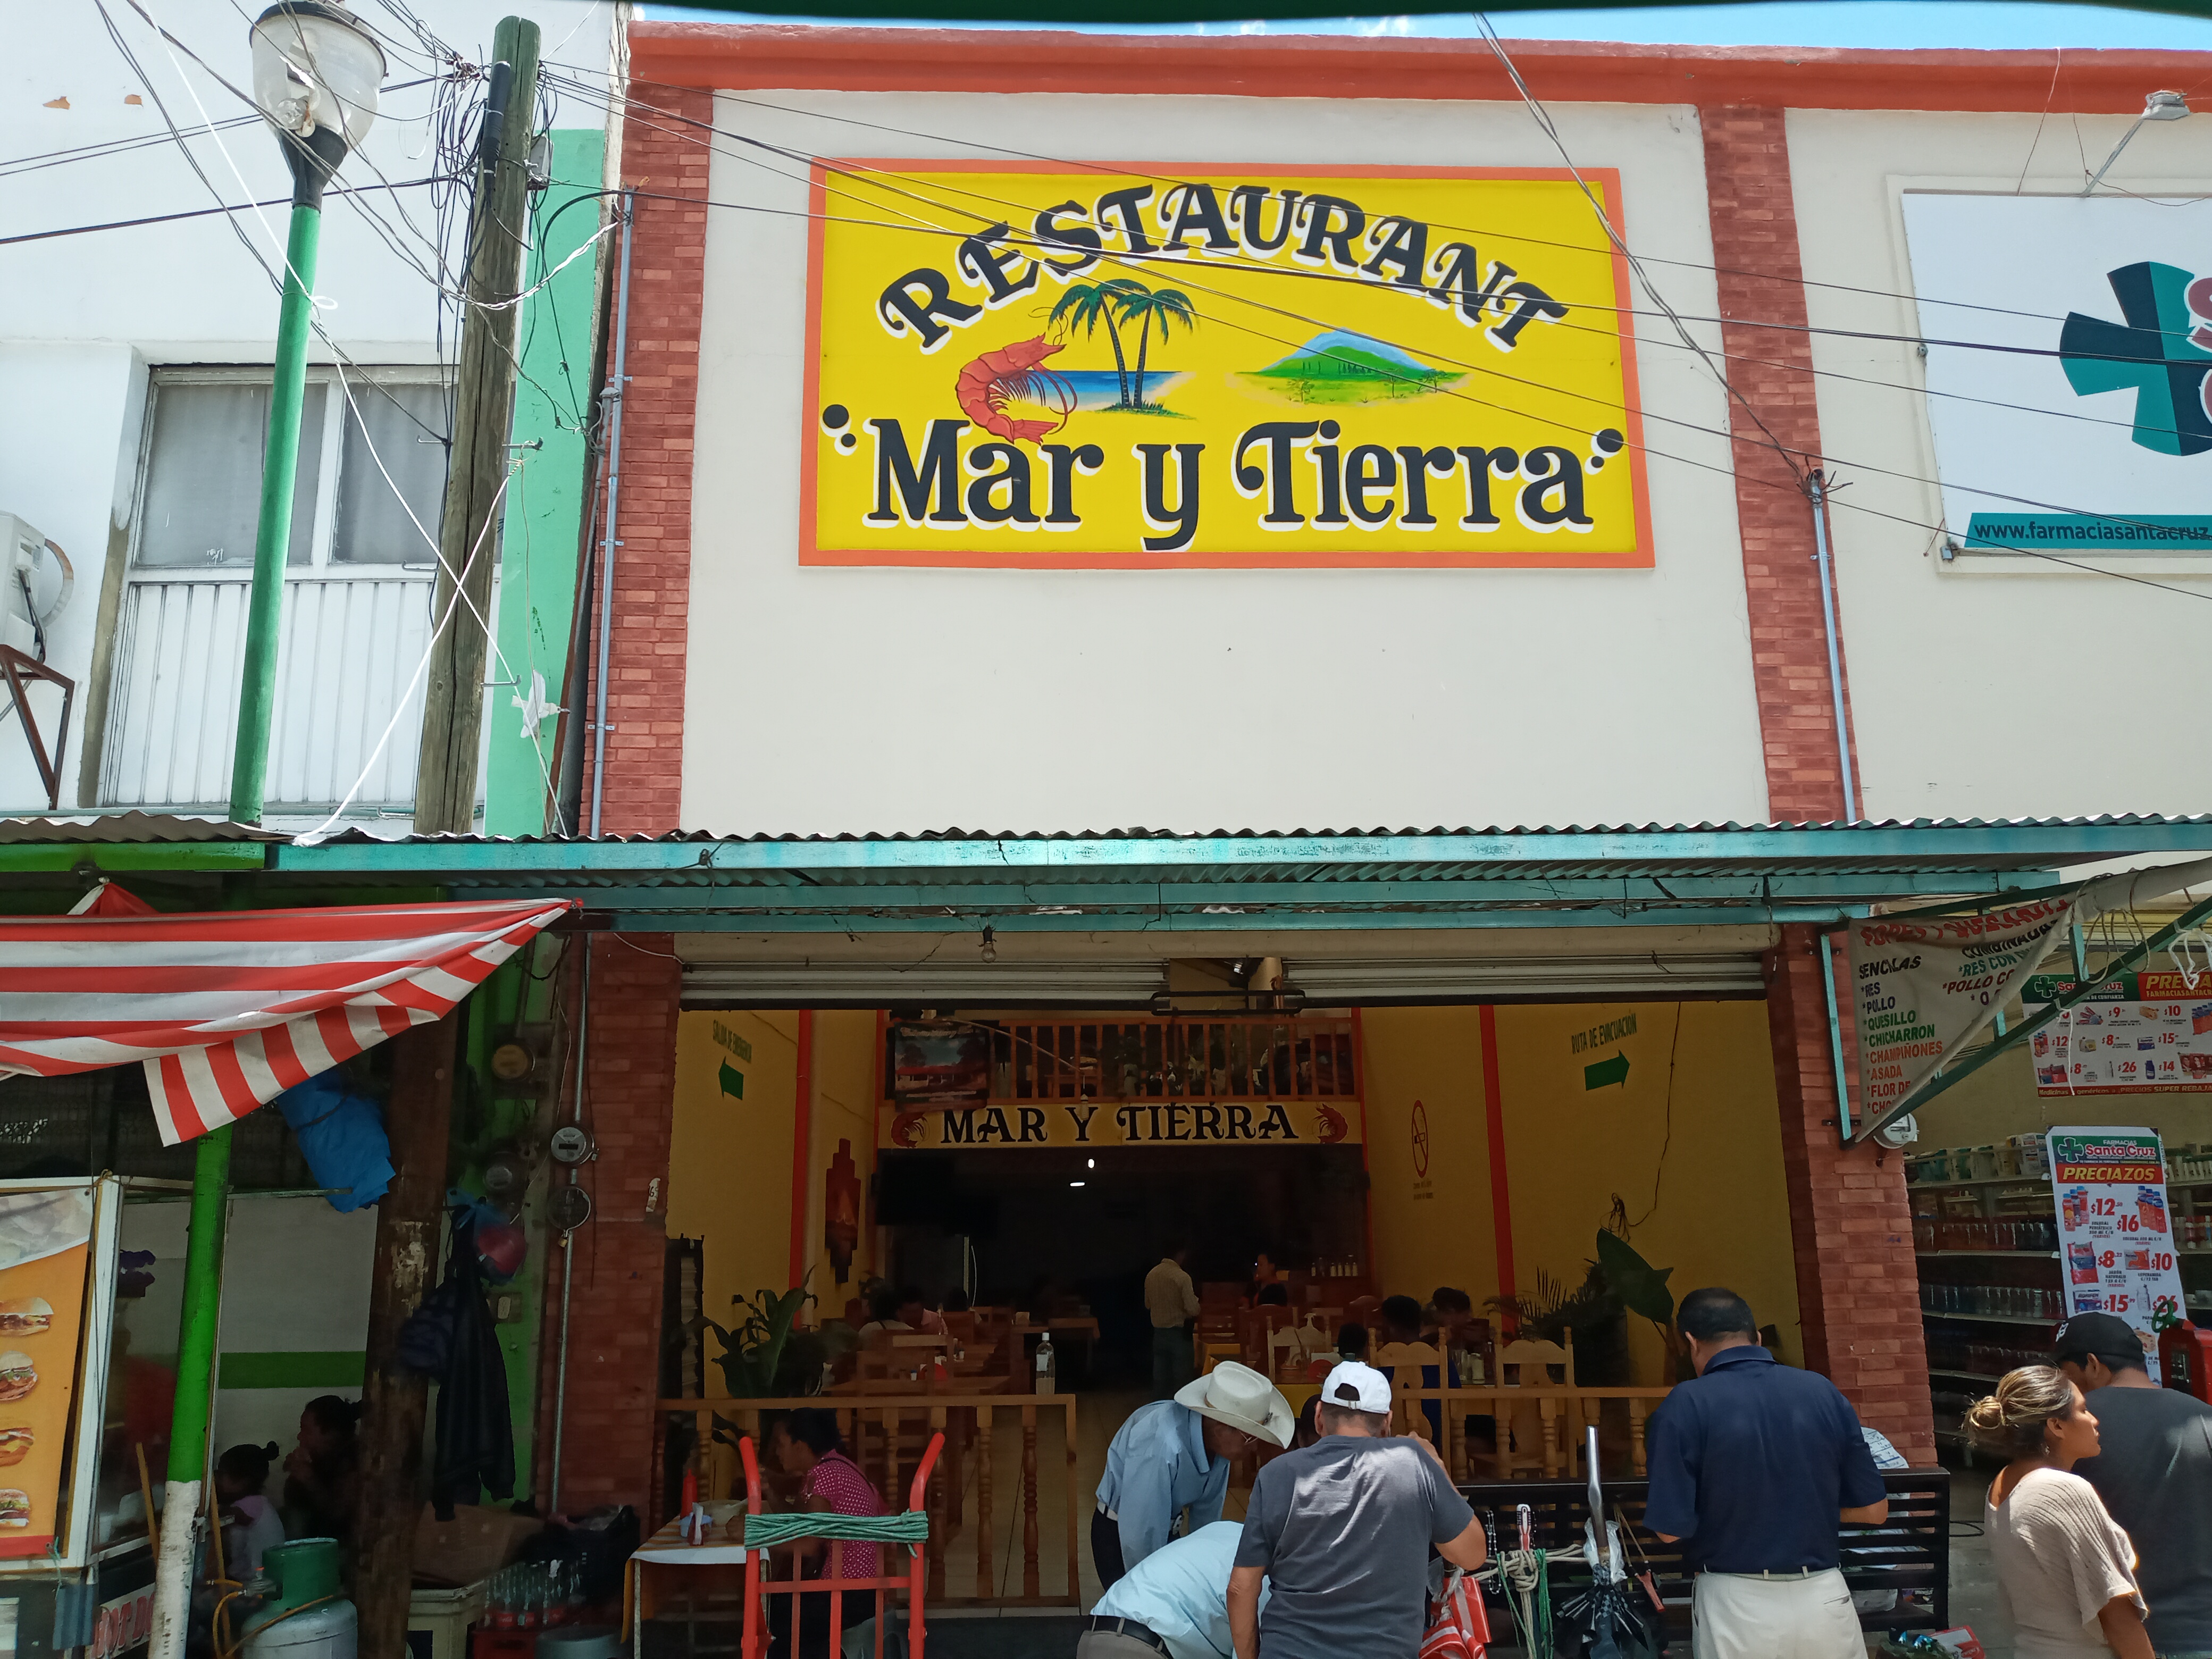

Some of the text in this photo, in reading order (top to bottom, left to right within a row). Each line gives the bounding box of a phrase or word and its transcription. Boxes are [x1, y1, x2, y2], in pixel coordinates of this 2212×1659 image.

[878, 183, 1570, 350] RESTAURANT
[862, 417, 1595, 551] Mar y Tierra
[940, 1102, 1299, 1143] MAR Y TIERRA
[2084, 1143, 2125, 1157] Santa
[2126, 1144, 2157, 1157] Cruz
[2063, 1167, 2156, 1182] PRECIAZOS
[2117, 1214, 2139, 1232] $16
[2151, 1253, 2173, 1271] $10
